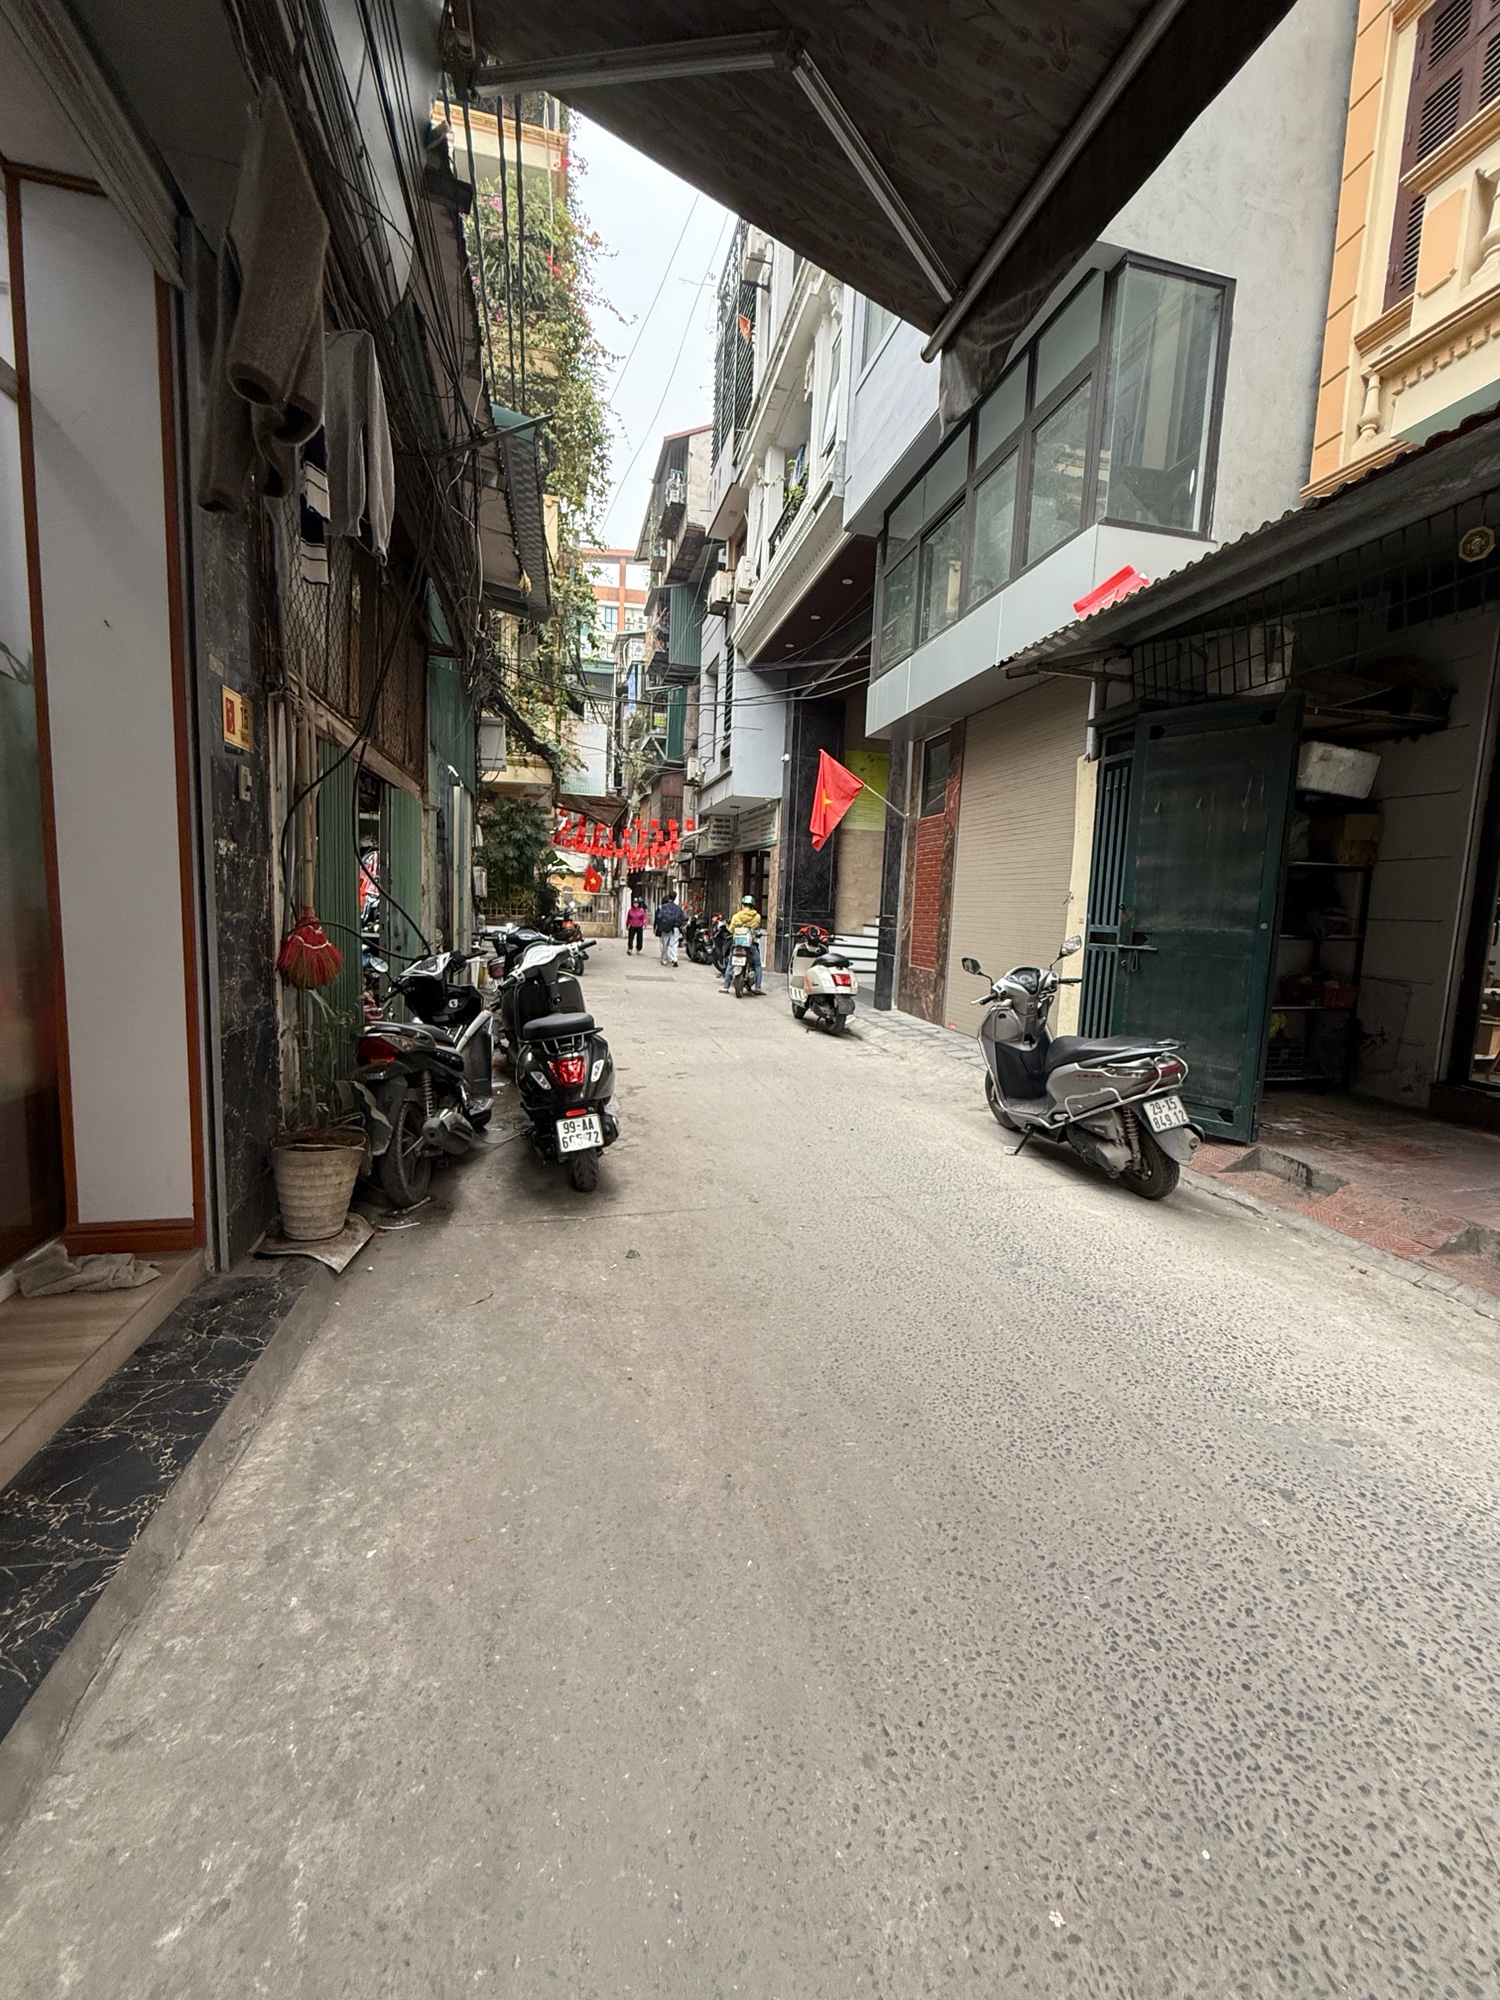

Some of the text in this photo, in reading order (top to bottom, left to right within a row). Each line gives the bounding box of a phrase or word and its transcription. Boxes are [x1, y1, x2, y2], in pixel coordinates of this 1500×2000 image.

[1149, 1097, 1178, 1115] 29-X5
[562, 1117, 595, 1134] 99-AA
[1152, 1110, 1186, 1129] 849.12
